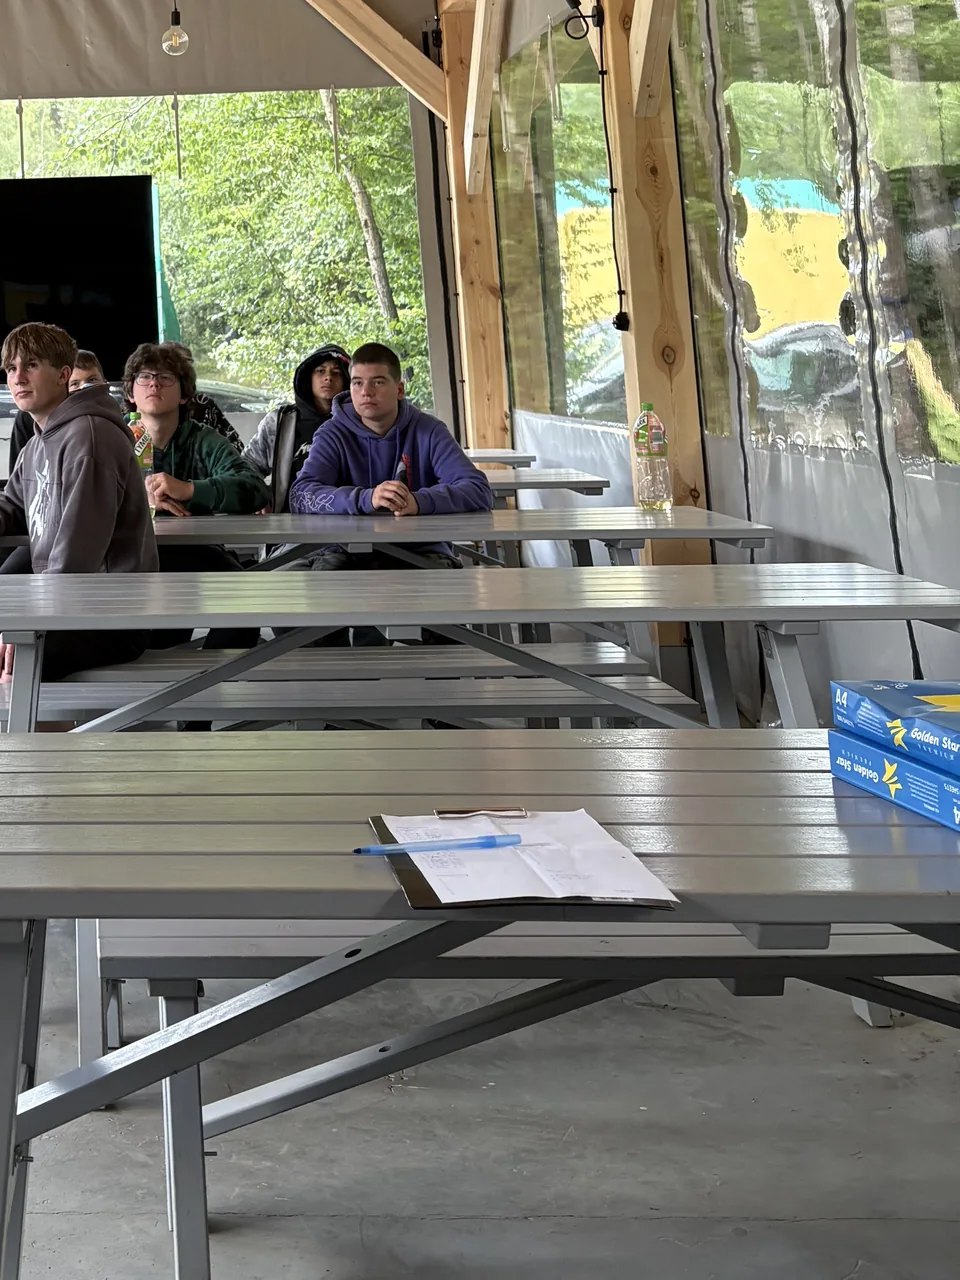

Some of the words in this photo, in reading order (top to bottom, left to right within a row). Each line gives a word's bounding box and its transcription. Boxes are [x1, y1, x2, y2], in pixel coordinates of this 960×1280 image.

[835, 688, 848, 708] A4
[910, 727, 939, 746] Golden
[941, 736, 960, 752] Star
[836, 756, 852, 772] Star
[853, 763, 879, 783] Golden
